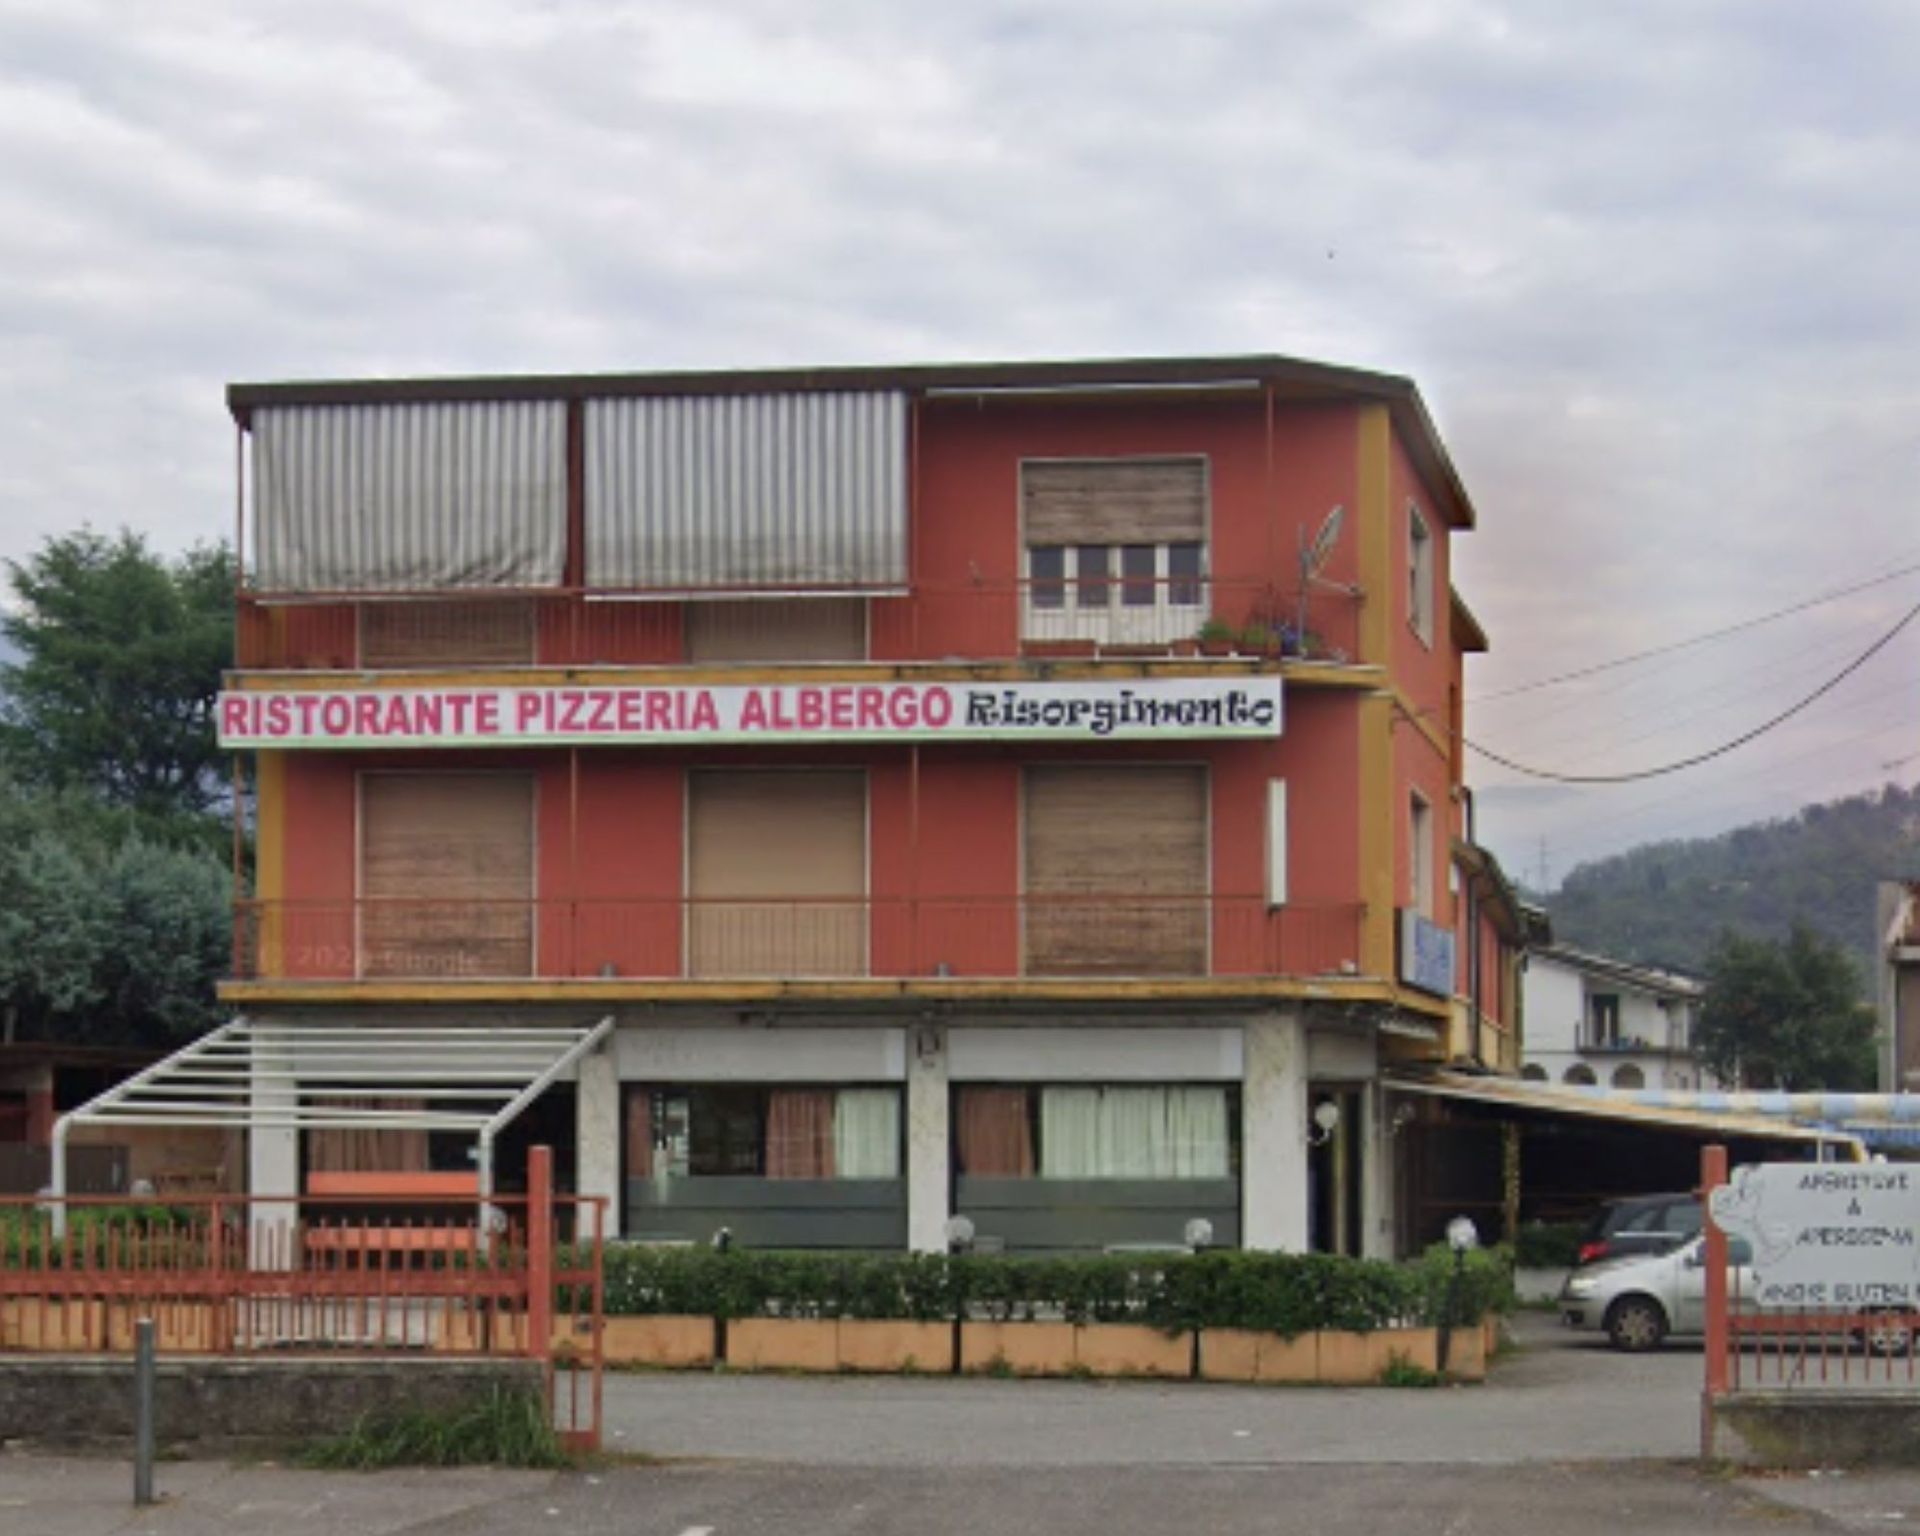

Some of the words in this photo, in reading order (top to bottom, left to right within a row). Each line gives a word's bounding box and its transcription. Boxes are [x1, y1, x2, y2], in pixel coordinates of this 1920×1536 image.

[221, 693, 500, 737] RISTORANTE
[516, 690, 720, 732] PIZZERIA
[739, 685, 954, 732] ALBERGO
[964, 690, 1275, 734] Risorgimento
